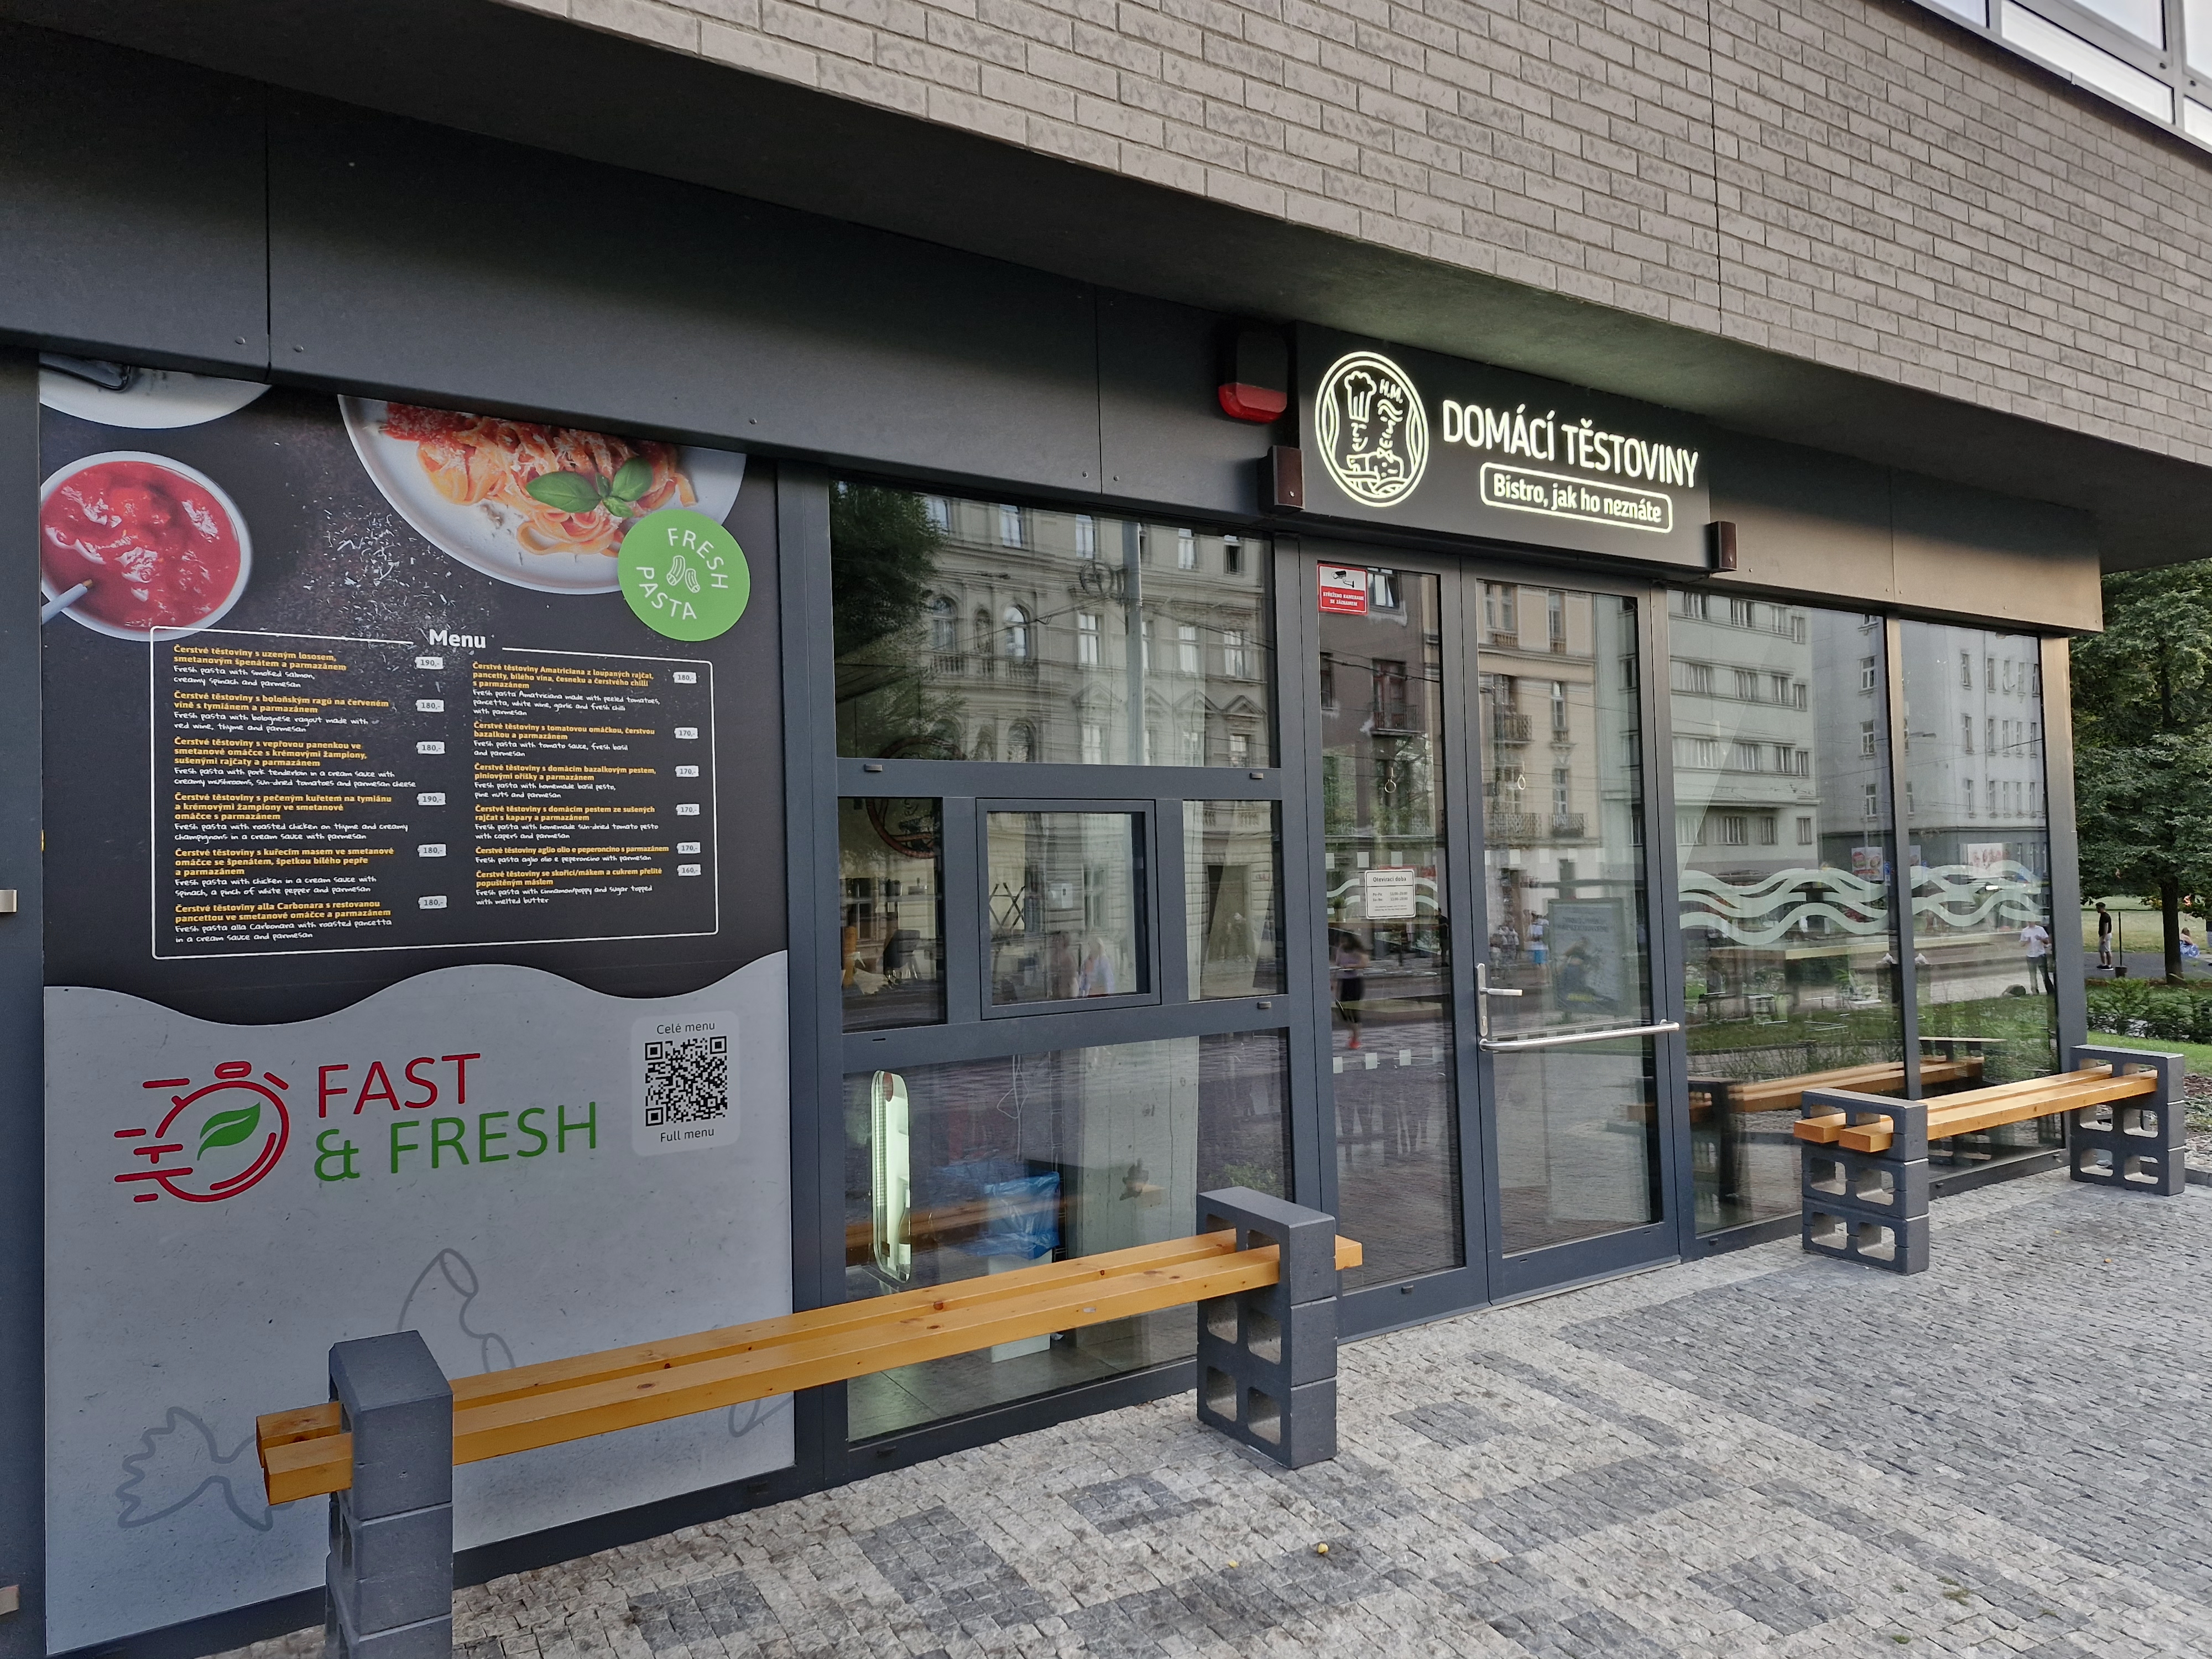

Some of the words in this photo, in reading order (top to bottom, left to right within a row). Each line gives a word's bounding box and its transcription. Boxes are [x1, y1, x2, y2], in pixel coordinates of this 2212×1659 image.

[1443, 399, 1555, 461] DOMÁCÍ
[1561, 418, 1698, 488] TĚSTOVINY
[1494, 472, 1548, 508] Bistro,
[1551, 483, 1577, 511] jak
[1580, 487, 1600, 513] ho
[1604, 498, 1662, 523] neznáte
[667, 528, 728, 588] FRESH
[636, 567, 697, 620] PASTA
[429, 629, 486, 649] Menu
[211, 647, 253, 658] těstoviny
[262, 651, 296, 660] uzeným
[299, 651, 337, 662] lososem,
[174, 656, 233, 666] smetanovým
[289, 662, 347, 671] parmazánem
[251, 669, 282, 677] smoked
[174, 677, 206, 686] creamy
[208, 677, 239, 686] spinach
[519, 690, 563, 700] Amatriciana
[200, 712, 226, 721] pasta
[251, 713, 291, 725] bolognese
[294, 716, 323, 726] ragout
[217, 723, 244, 733] thyme
[504, 723, 540, 732] těstoviny
[212, 738, 254, 748] těstoviny
[262, 740, 304, 749] vepřovou
[306, 741, 349, 749] panenkou
[495, 740, 518, 749] pasta
[591, 742, 611, 750] fresh
[212, 794, 254, 803] těstoviny
[357, 795, 392, 804] tymiánu
[221, 813, 280, 821] parmazánem
[497, 823, 519, 832] pasta
[640, 823, 659, 831] pesto
[174, 833, 228, 843] champignons
[327, 833, 367, 841] parmesan
[498, 856, 519, 865] pasta
[521, 856, 539, 866] aglio
[220, 888, 241, 897] pinch
[243, 886, 255, 895] of
[284, 888, 311, 896] pepper
[331, 886, 371, 895] parmesan
[213, 904, 255, 912] těstoviny
[202, 924, 228, 933] pasta
[249, 922, 295, 930] Carbonara
[354, 919, 392, 928] pancetta
[657, 1024, 681, 1035] Celé
[685, 1022, 715, 1032] menu
[319, 1053, 481, 1118] FAST
[661, 1130, 681, 1142] Full
[685, 1129, 714, 1139] menu
[314, 1129, 360, 1182] &
[390, 1102, 596, 1173] FRESH
